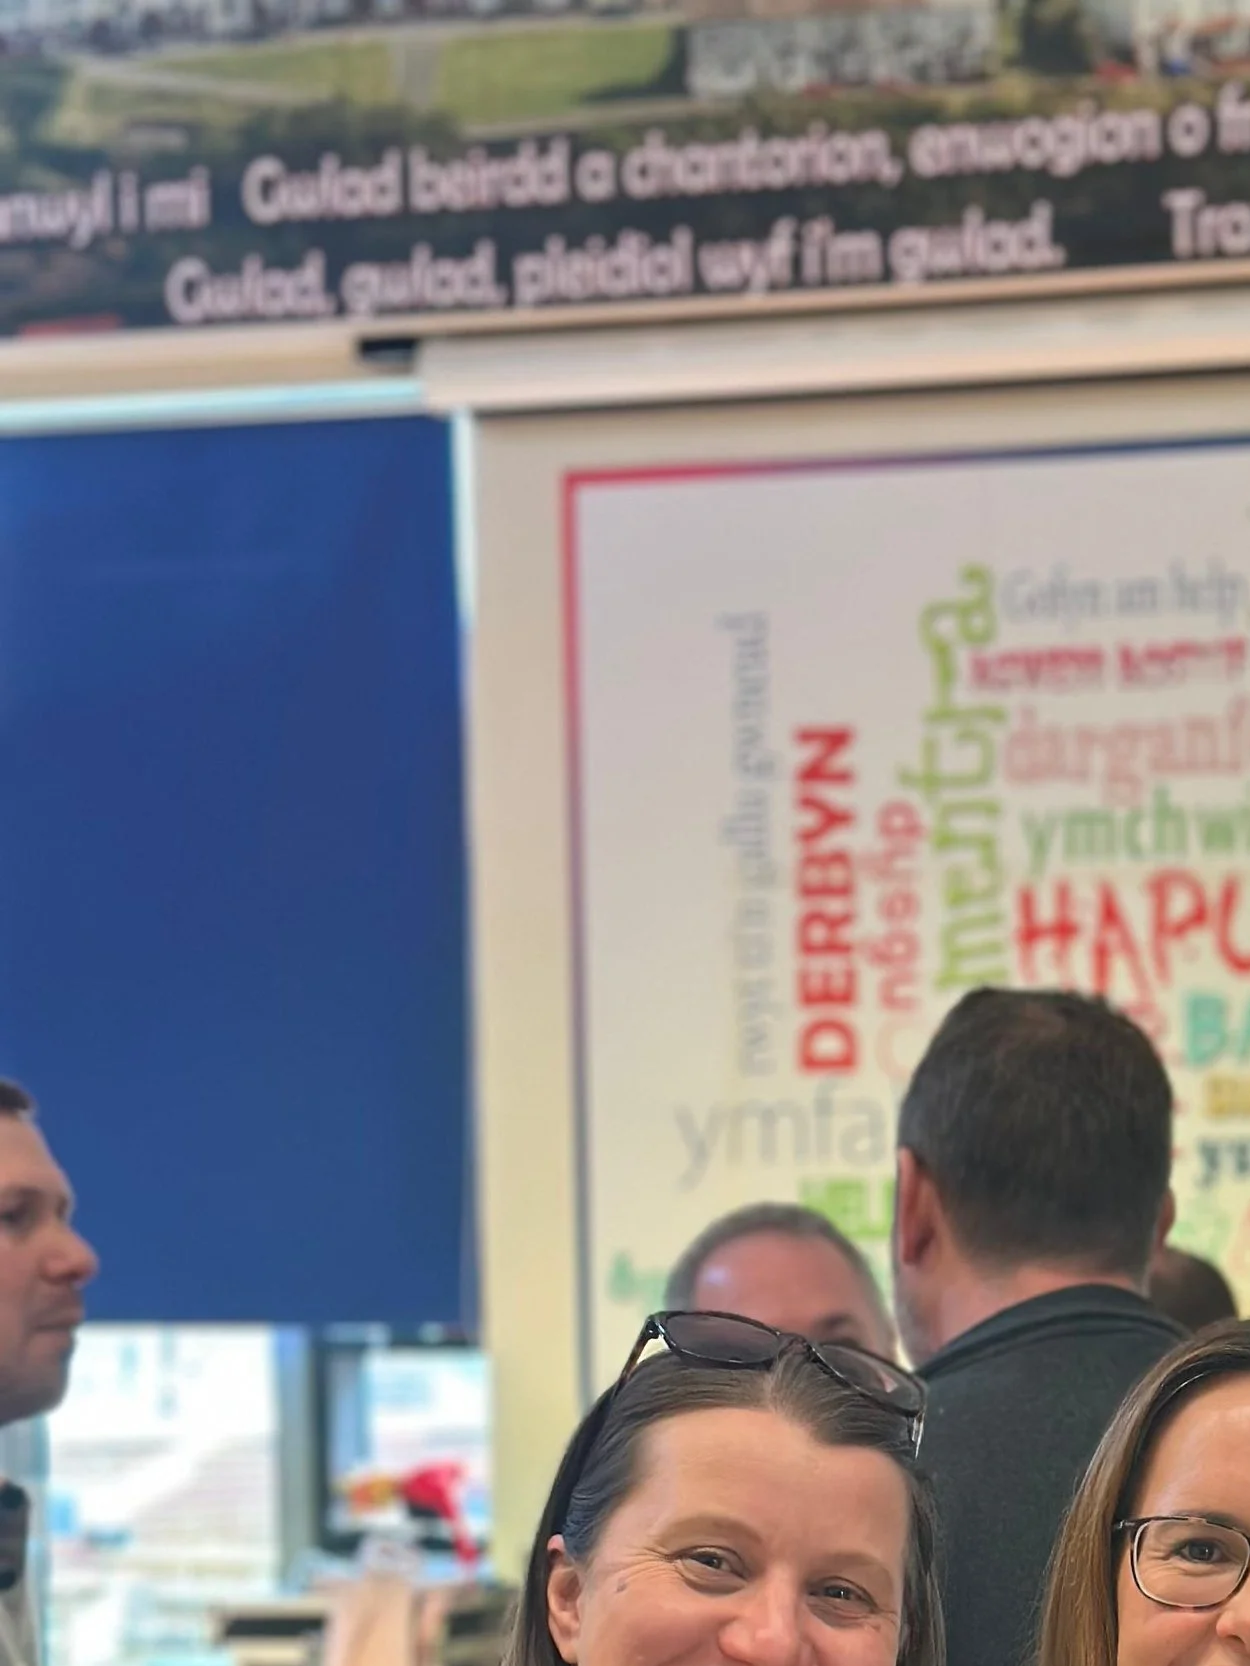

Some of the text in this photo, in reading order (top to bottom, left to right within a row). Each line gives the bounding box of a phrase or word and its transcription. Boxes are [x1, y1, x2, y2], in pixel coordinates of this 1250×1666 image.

[118, 171, 138, 231] i
[145, 165, 211, 232] mi
[242, 147, 402, 224] Gwlad
[408, 134, 572, 213] beirdd
[575, 150, 617, 201] a
[621, 126, 902, 200] chantorion,
[908, 100, 1164, 178] enwogion
[1167, 103, 1212, 157] o
[165, 248, 336, 325] Gwlad,
[341, 235, 508, 324] gwlad,
[512, 224, 696, 312] pleidiol
[697, 216, 800, 300] wyf
[793, 722, 857, 1076] DERBYN
